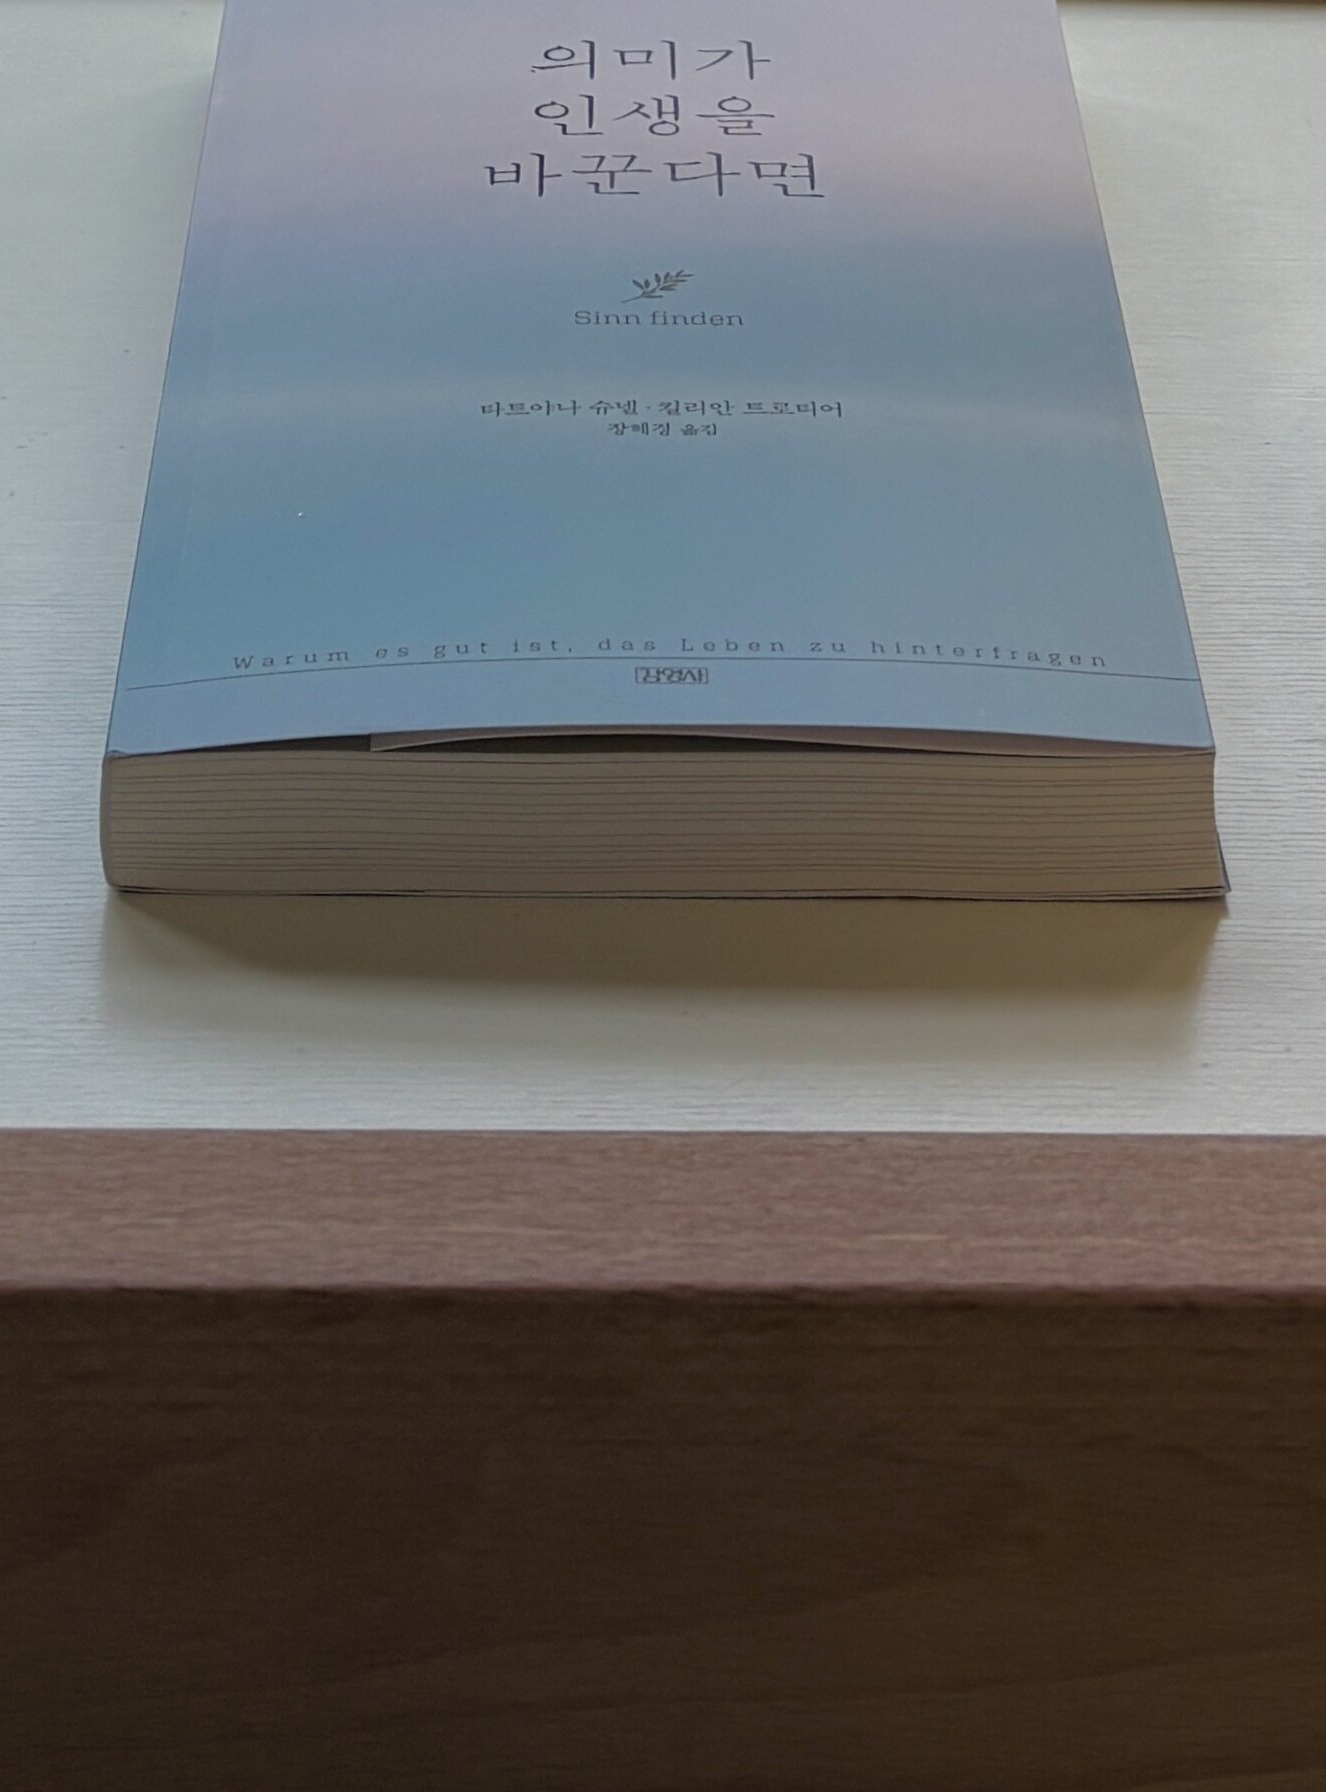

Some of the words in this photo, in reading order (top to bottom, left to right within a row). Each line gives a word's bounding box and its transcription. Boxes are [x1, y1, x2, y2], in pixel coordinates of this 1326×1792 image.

[531, 39, 771, 80] 의미가
[534, 94, 775, 136] 인생을
[484, 151, 825, 198] 바꾼다면
[574, 310, 641, 326] Sinn
[650, 310, 745, 327] finden
[658, 400, 735, 416] 킬리안
[680, 422, 718, 437] 옮김
[233, 649, 350, 670] Warum
[375, 644, 410, 658] es
[433, 641, 489, 660] gut
[597, 637, 657, 652] das
[680, 638, 785, 653] Leben
[810, 641, 847, 653] zu
[870, 639, 1107, 668] hinterfragen
